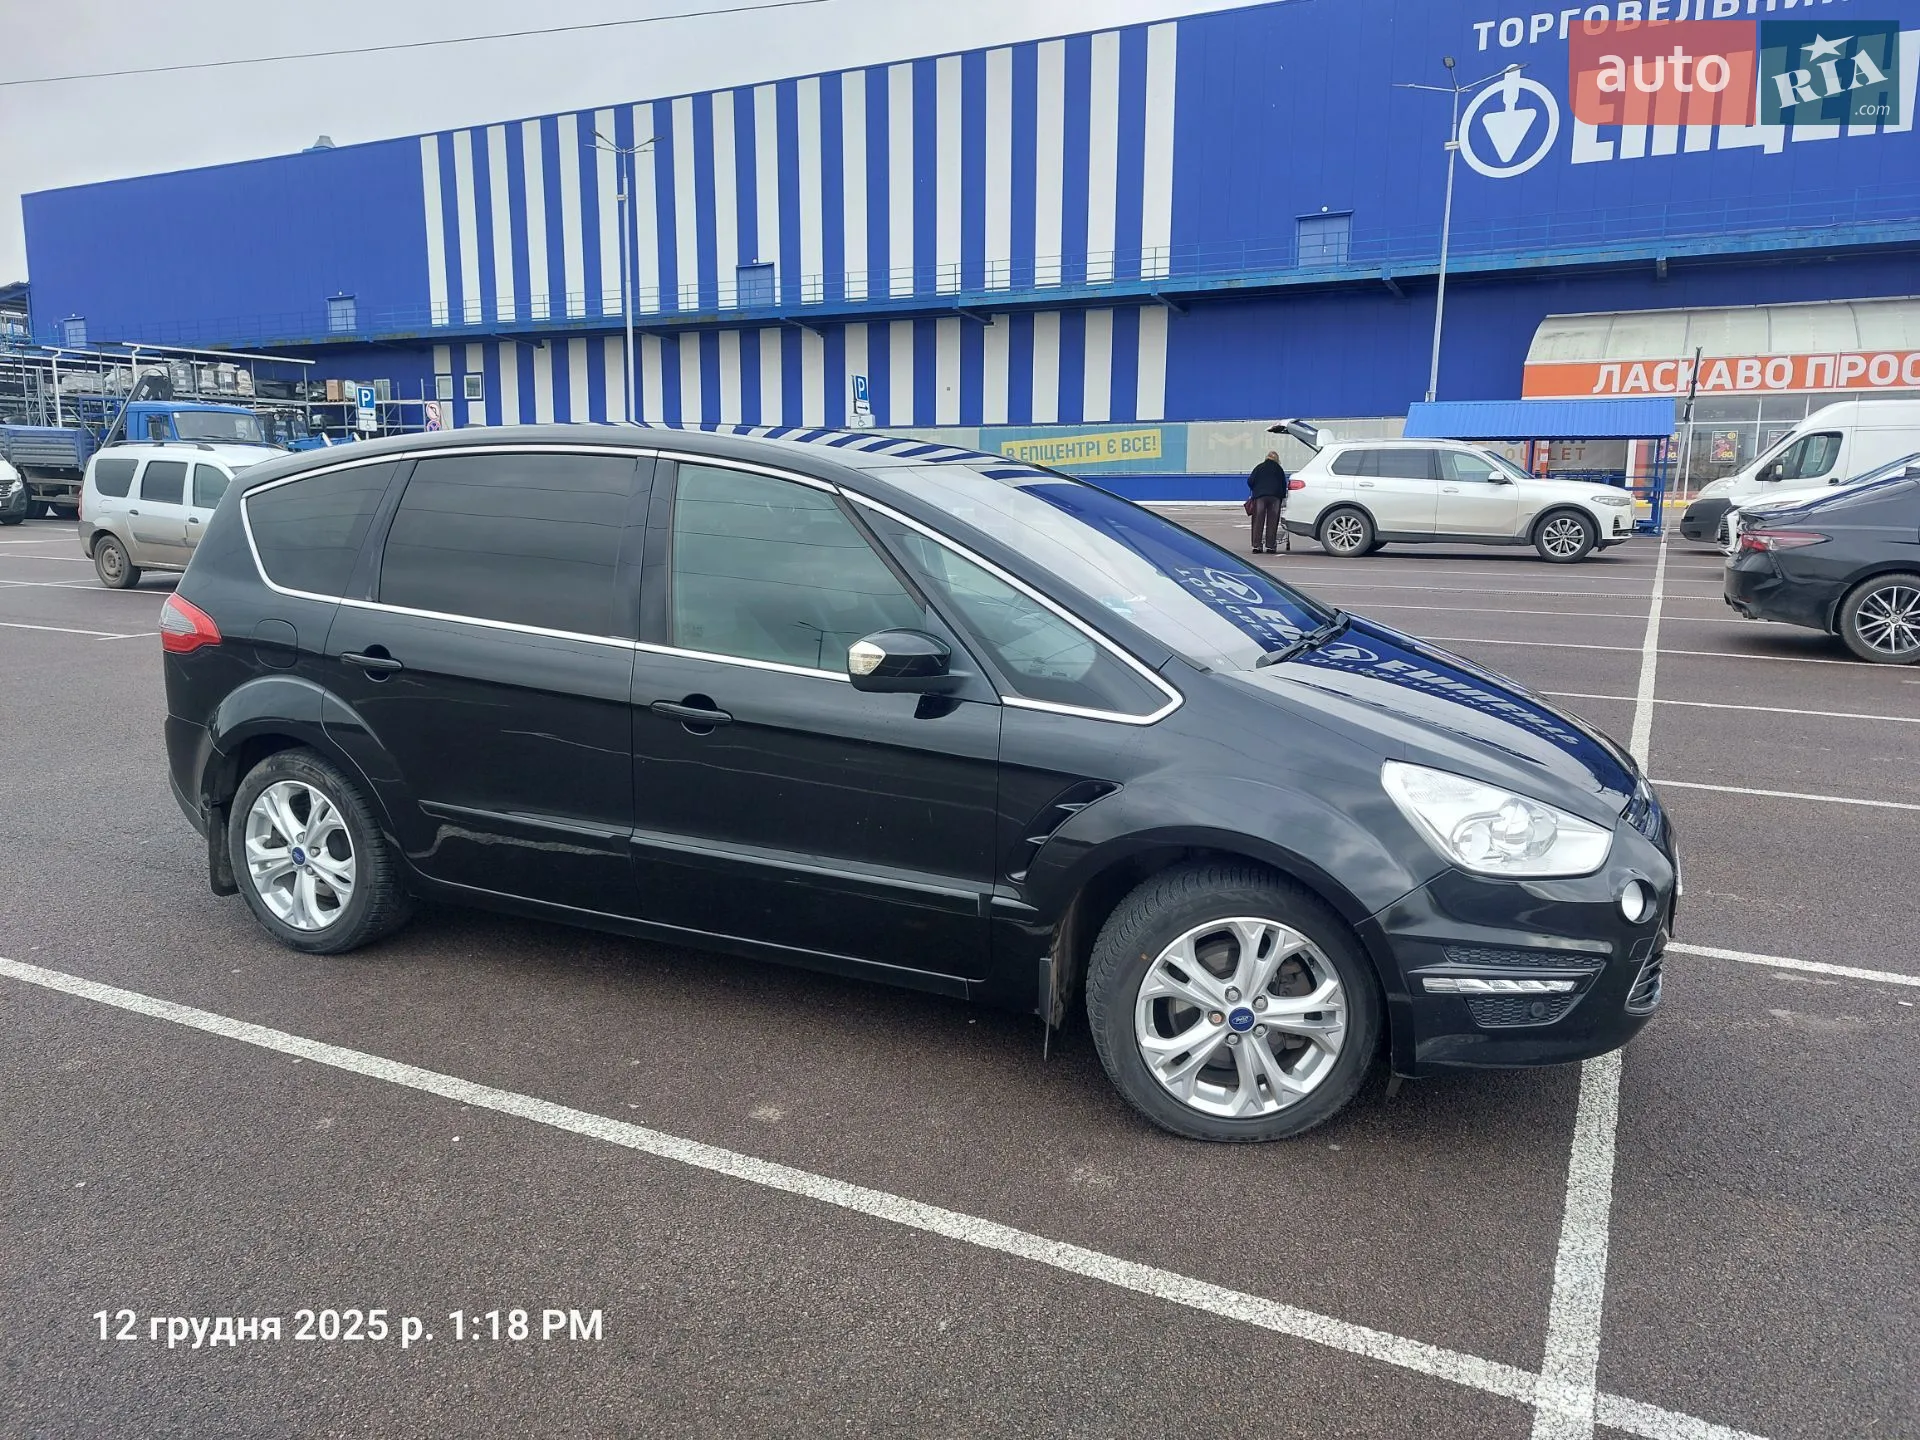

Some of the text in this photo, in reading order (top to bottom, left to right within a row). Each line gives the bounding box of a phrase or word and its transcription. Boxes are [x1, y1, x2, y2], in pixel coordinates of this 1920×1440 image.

[1592, 357, 1794, 394] ЛАСКАВО
[361, 389, 371, 407] P
[1020, 441, 1100, 463] ЕПІЦЕНТРІ
[1107, 439, 1117, 454] Є
[1121, 435, 1156, 453] ВСЕ!
